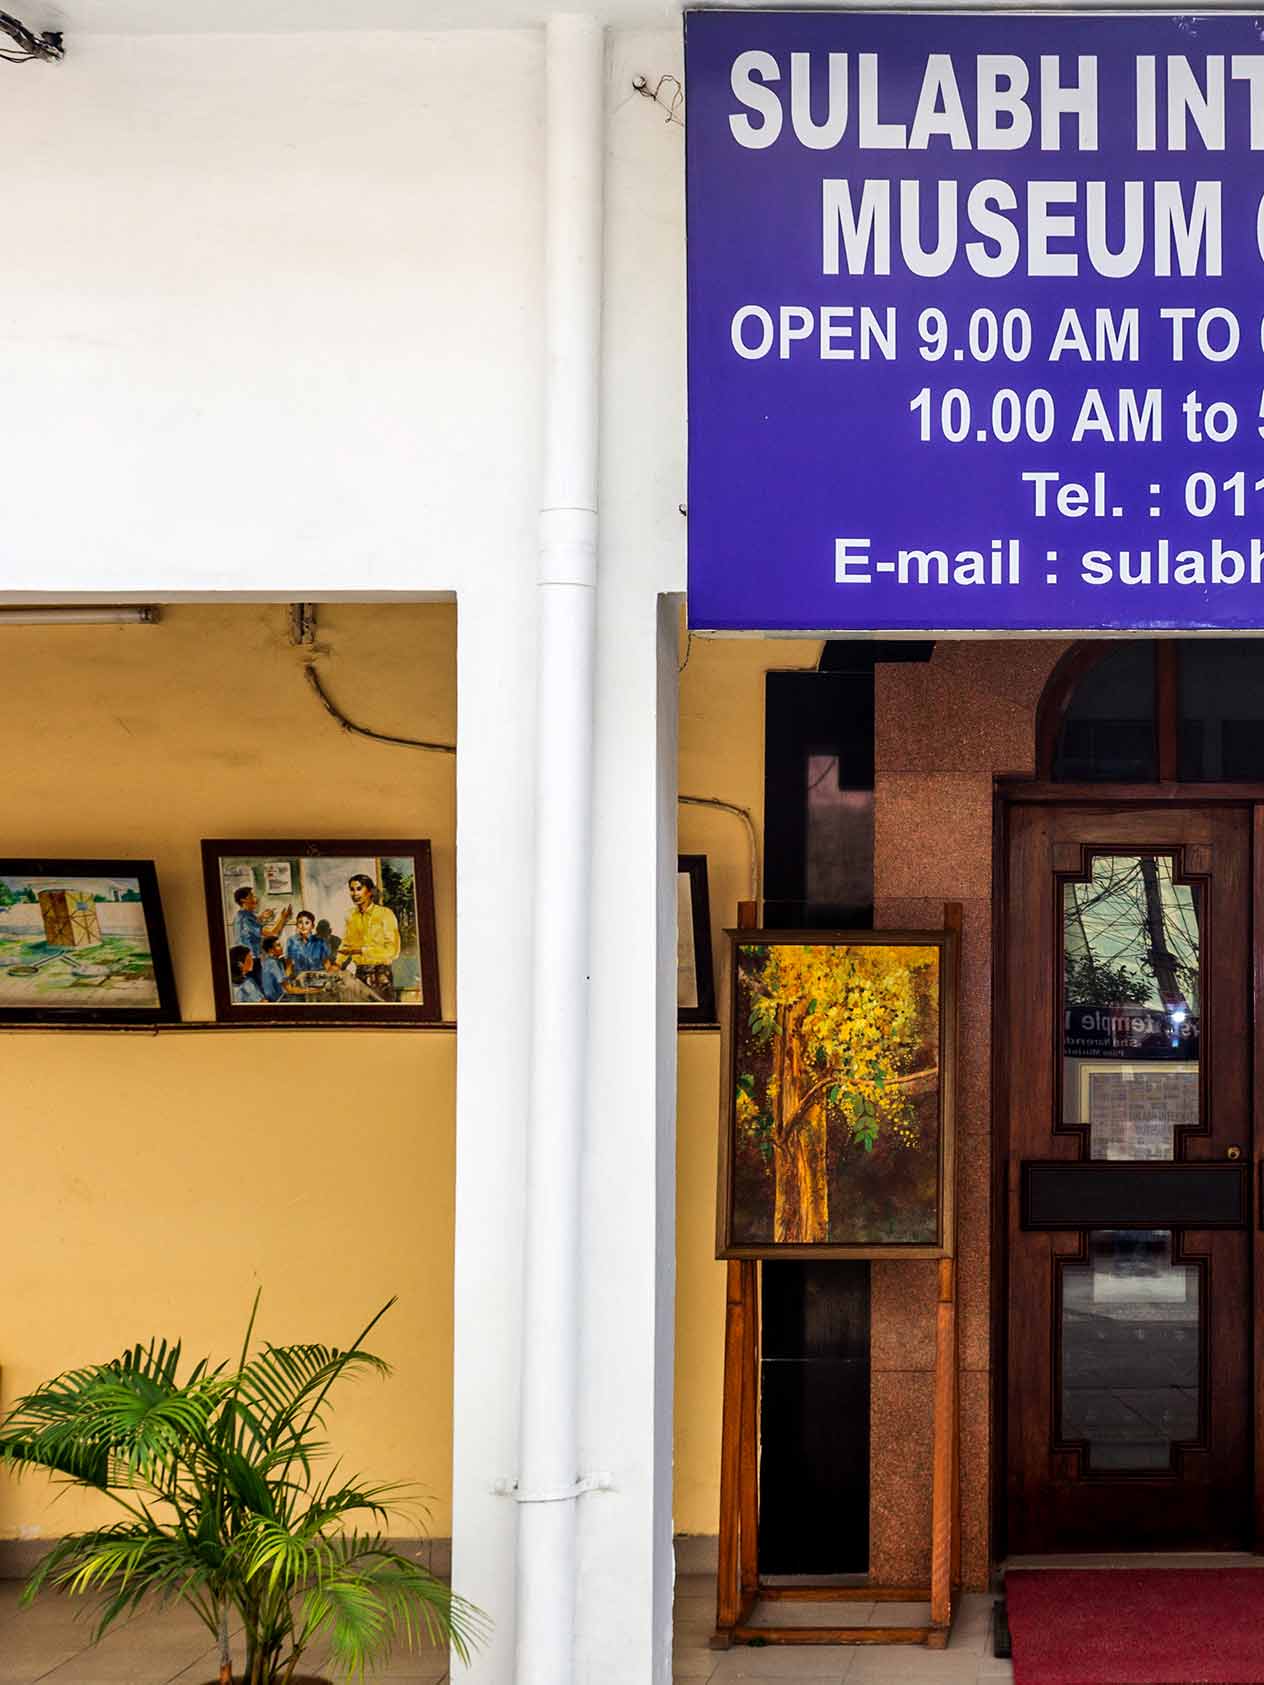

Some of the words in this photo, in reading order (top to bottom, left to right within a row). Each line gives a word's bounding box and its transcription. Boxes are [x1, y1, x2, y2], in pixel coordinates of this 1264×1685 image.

[728, 50, 1099, 151] SULABH
[822, 178, 1222, 279] MUSEUM
[730, 304, 897, 361] OPEN
[918, 307, 1032, 362] 9.00
[1048, 308, 1139, 362] AM
[1159, 307, 1240, 362] TO
[910, 387, 1055, 443] 10.00
[1071, 388, 1162, 442] AM
[1182, 390, 1238, 443] to
[1021, 471, 1123, 518] Tel.
[1149, 483, 1161, 517] :
[834, 538, 1020, 586] E-mail
[1046, 551, 1057, 584] :
